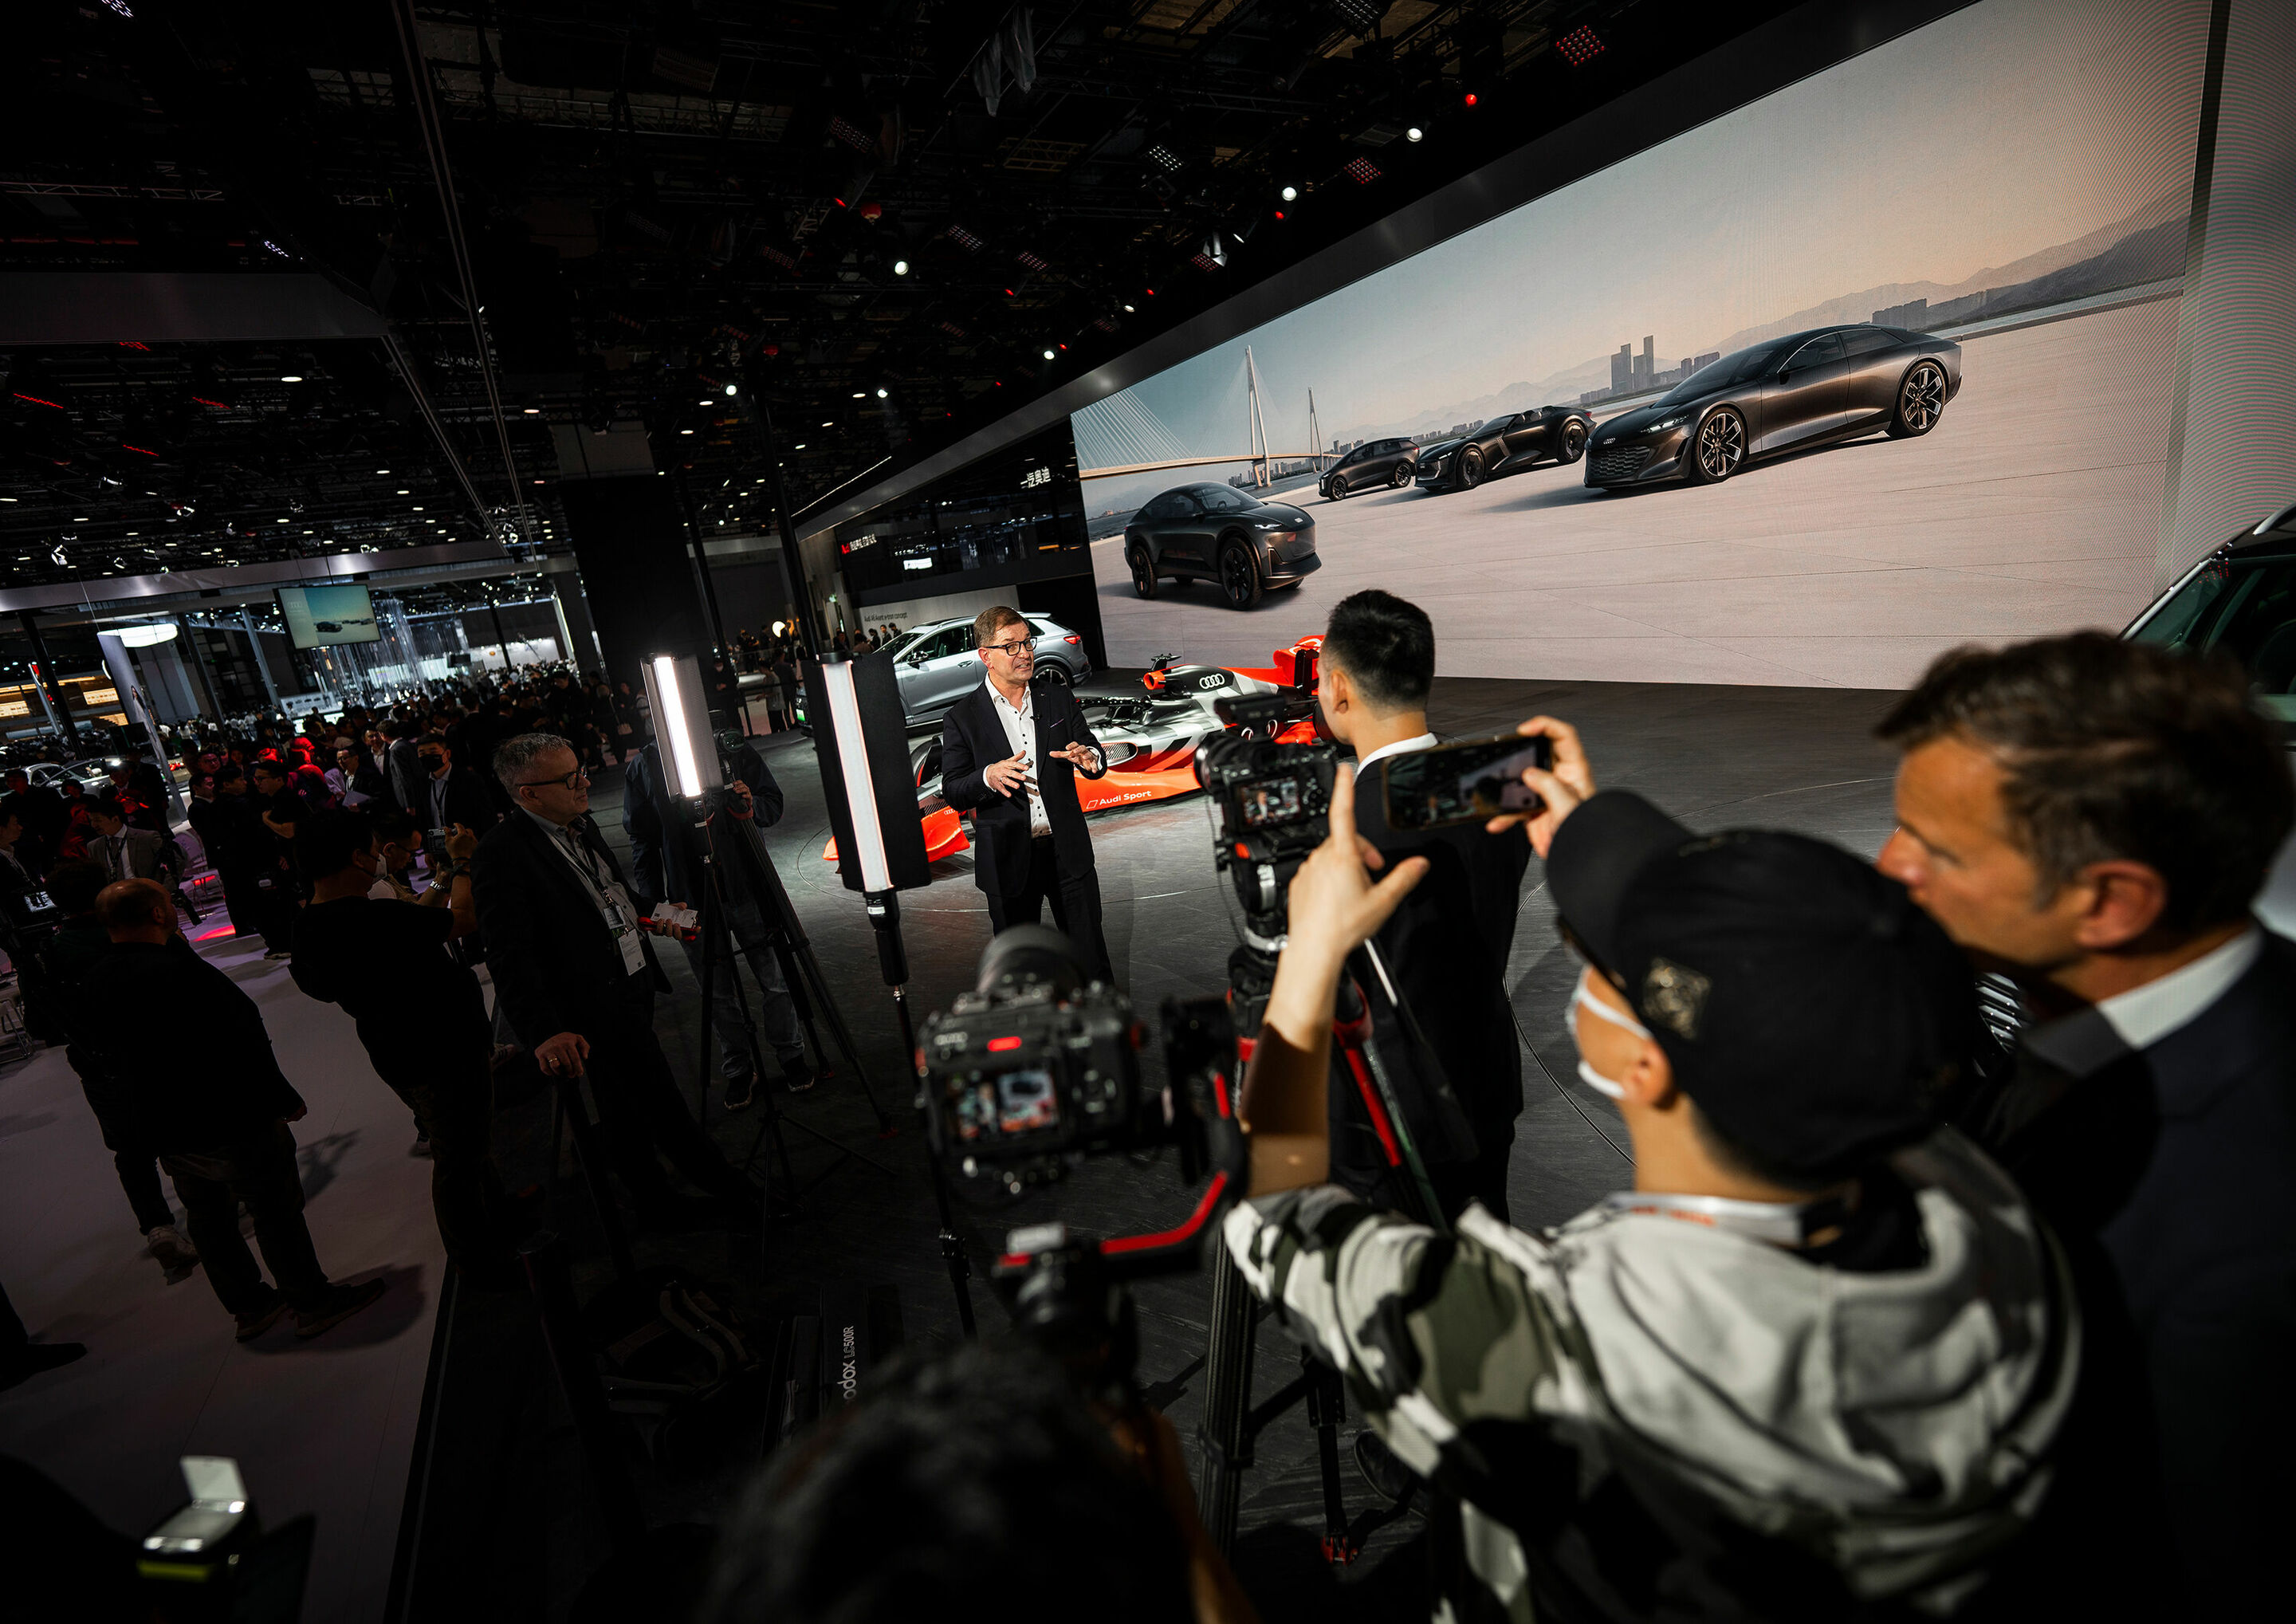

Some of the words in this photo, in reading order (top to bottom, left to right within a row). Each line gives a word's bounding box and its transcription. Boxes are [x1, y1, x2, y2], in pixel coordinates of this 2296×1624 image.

[1020, 466, 1052, 489] 一汽奥迪
[1099, 795, 1122, 805] Audi
[1123, 790, 1152, 800] Sport
[843, 1325, 855, 1359] LC500R
[836, 1359, 857, 1401] odox
